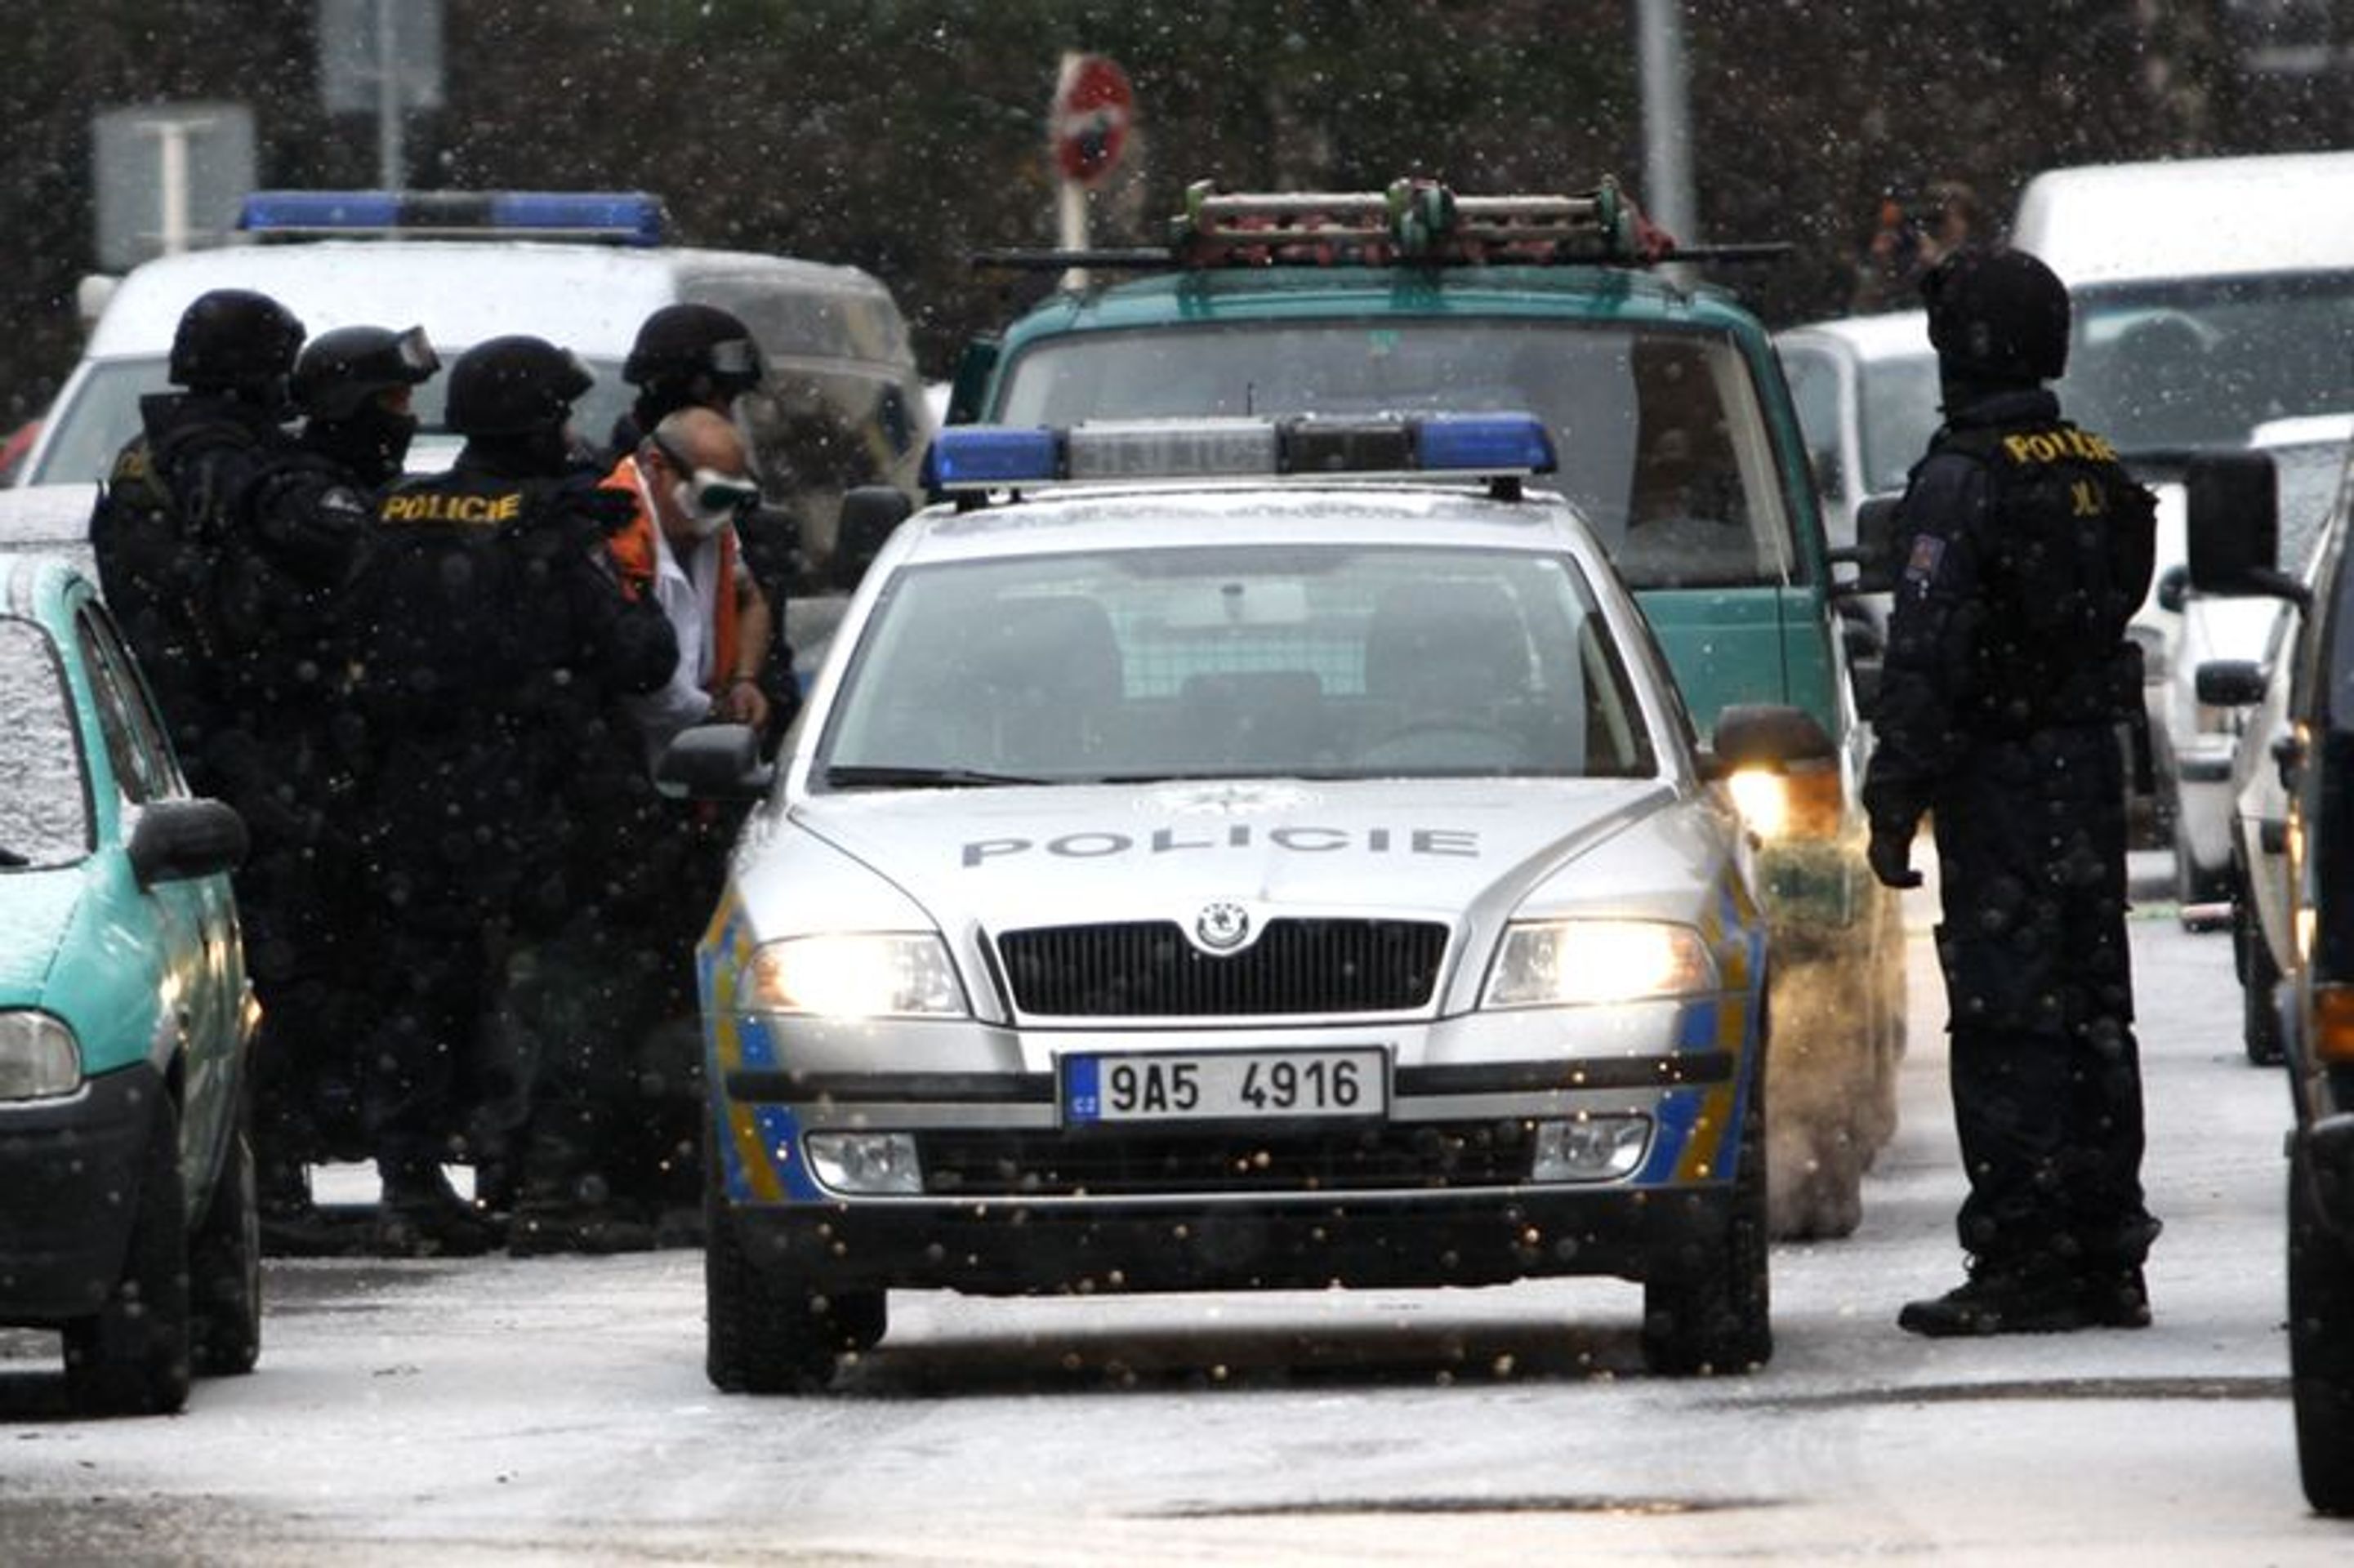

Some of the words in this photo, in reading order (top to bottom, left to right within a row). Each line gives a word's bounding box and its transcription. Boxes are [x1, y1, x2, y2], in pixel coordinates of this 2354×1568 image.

[381, 492, 523, 522] POLICIE
[961, 824, 1481, 867] POLICIE
[1110, 1063, 1199, 1112] 9A5
[1240, 1059, 1360, 1109] 4916
